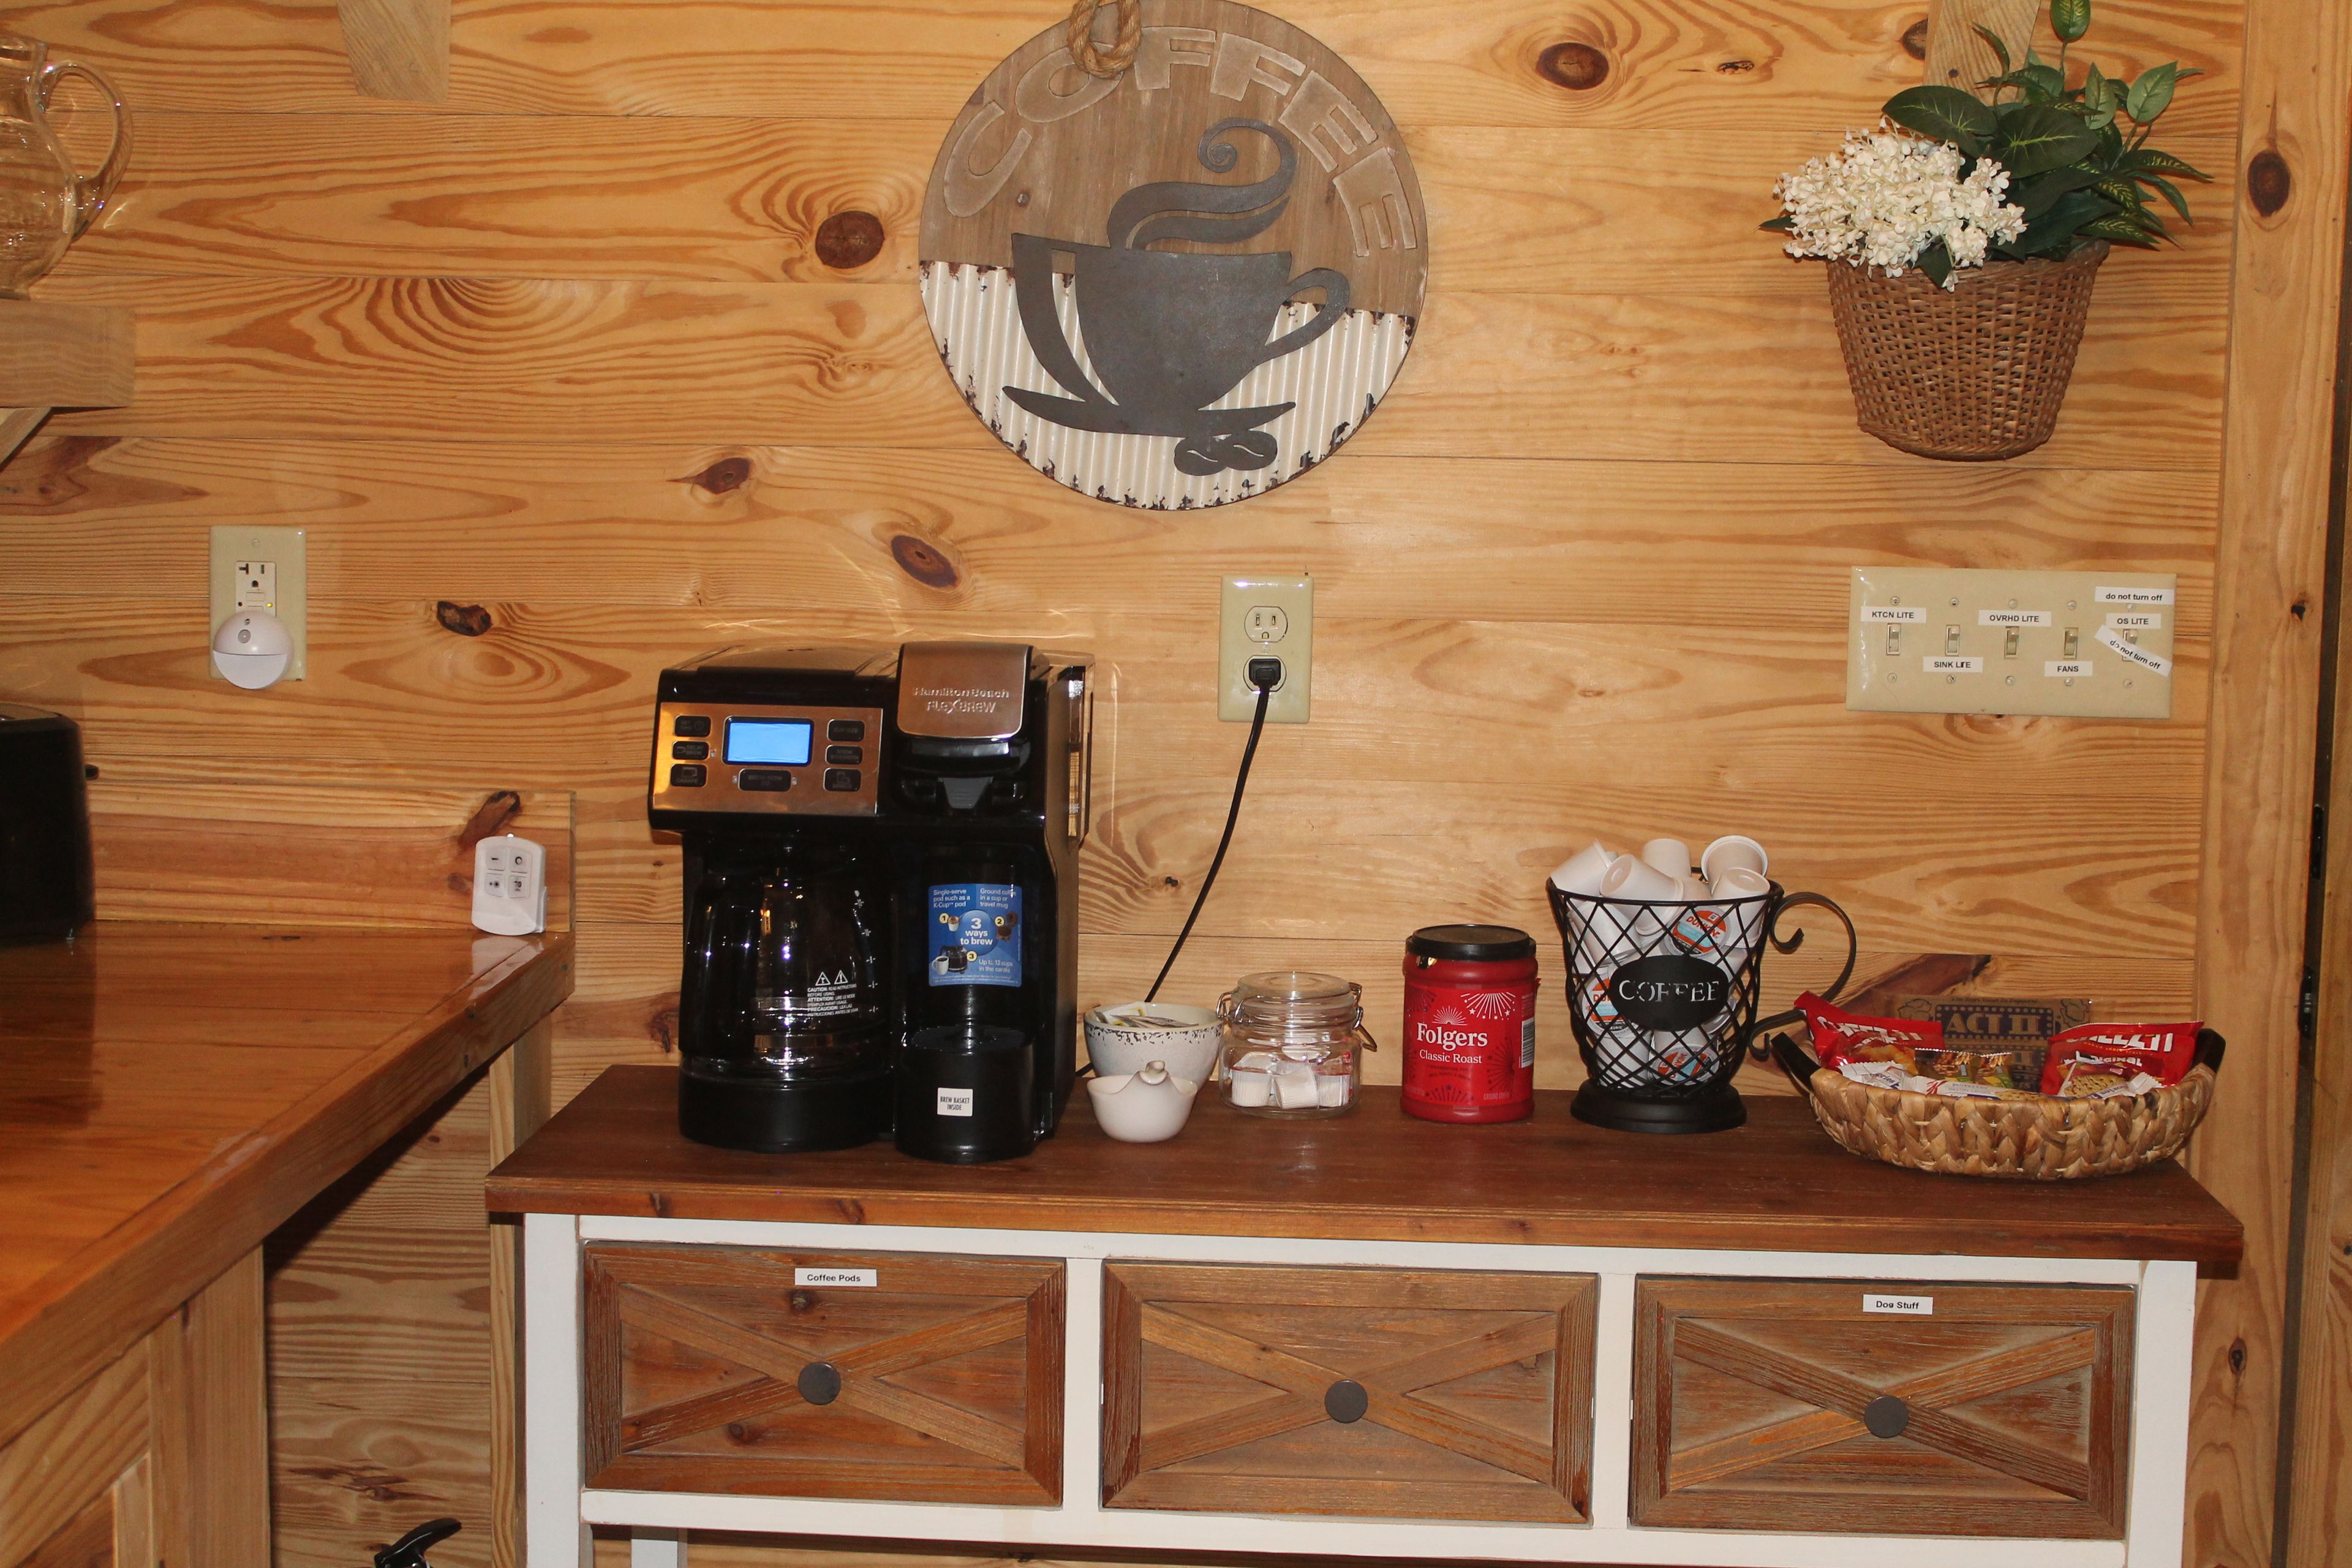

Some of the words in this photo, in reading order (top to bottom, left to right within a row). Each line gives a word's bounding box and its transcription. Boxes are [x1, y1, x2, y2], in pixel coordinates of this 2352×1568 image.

[944, 26, 1418, 257] COFFEE
[2109, 639, 2120, 649] do
[2120, 646, 2133, 657] not
[2133, 653, 2148, 664] turn
[2149, 659, 2161, 669] off
[971, 918, 982, 929] 3
[1686, 916, 1721, 937] DUNKN'
[1946, 1013, 2003, 1035] ACT
[2008, 1014, 2042, 1035] II
[1417, 1022, 1488, 1050] Folgers
[1420, 1049, 1450, 1062] Classic
[1453, 1054, 1482, 1063] Roast
